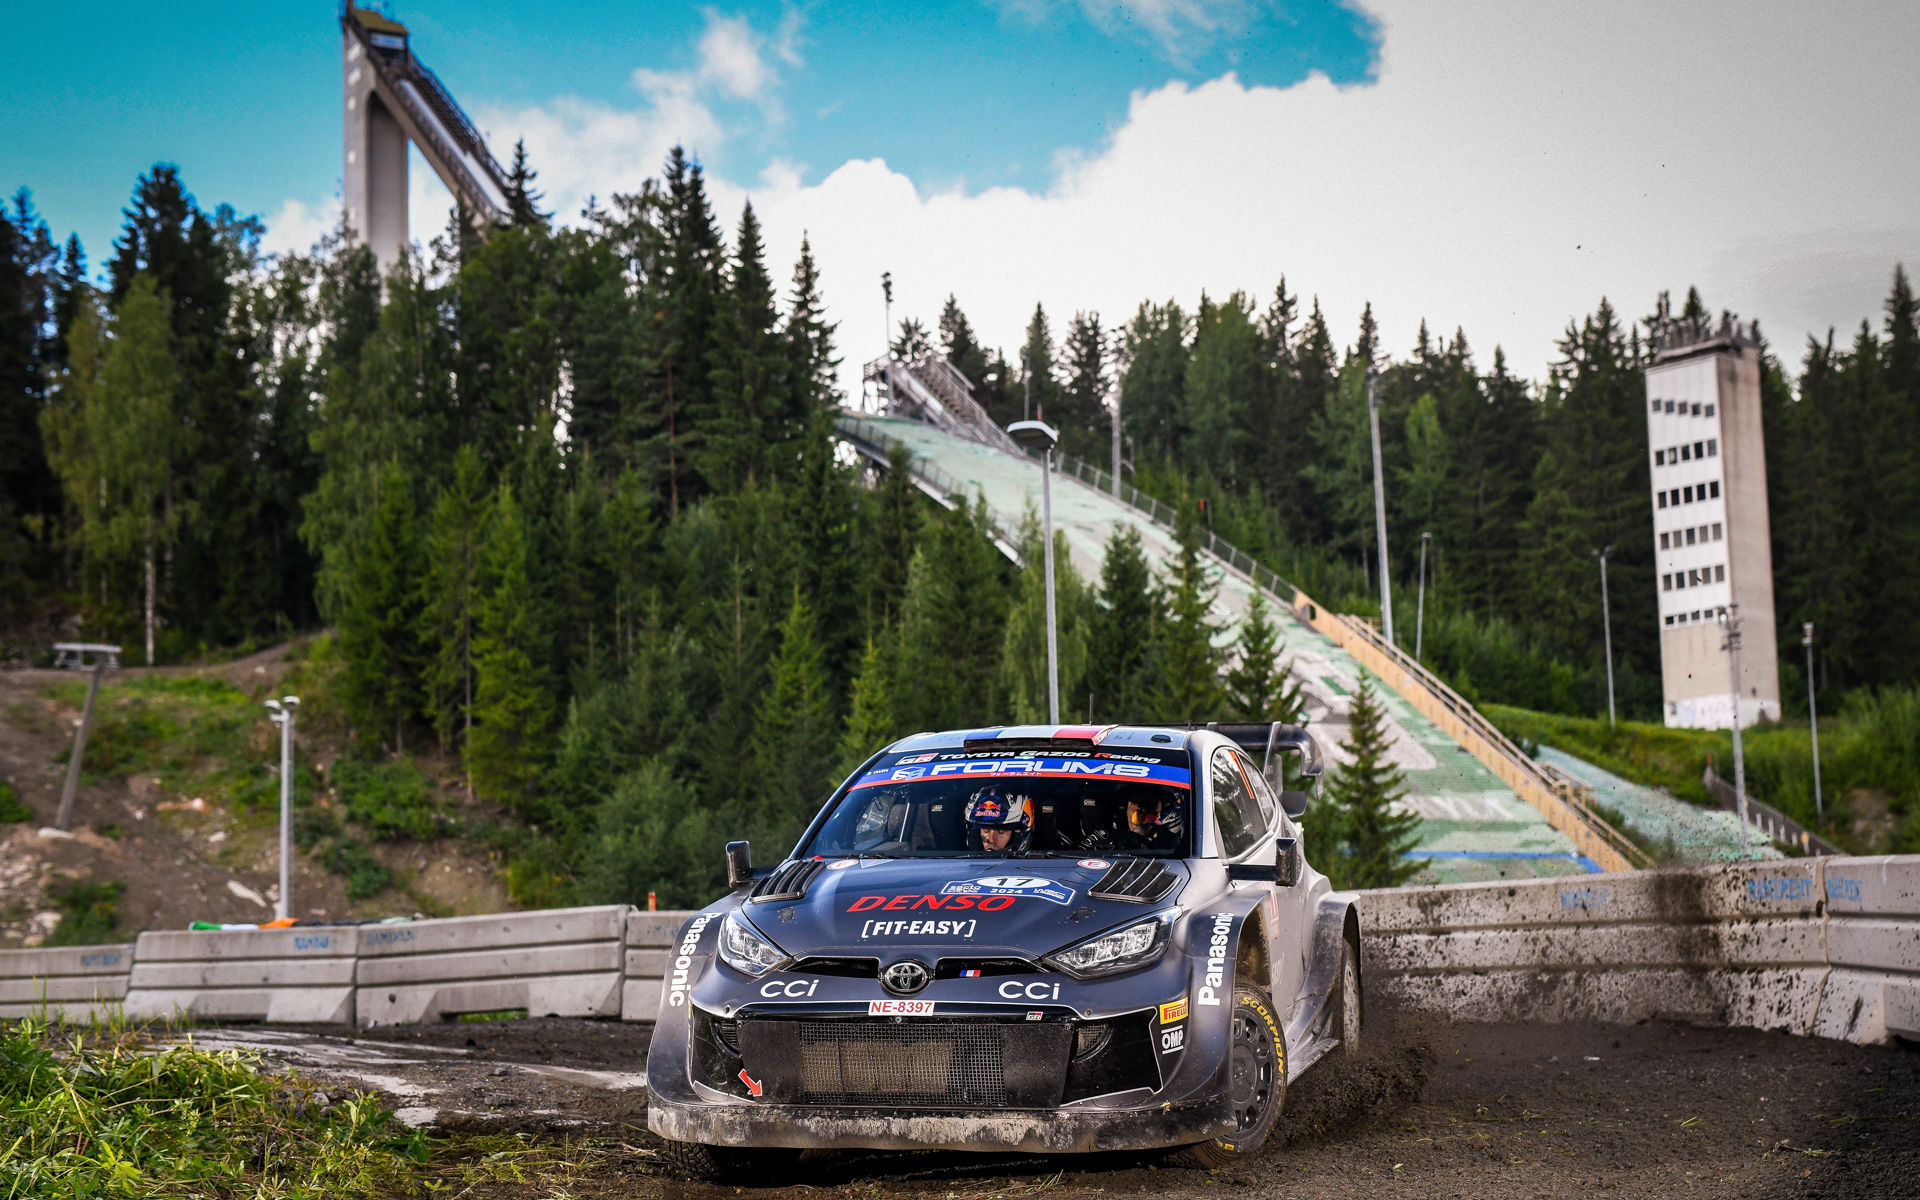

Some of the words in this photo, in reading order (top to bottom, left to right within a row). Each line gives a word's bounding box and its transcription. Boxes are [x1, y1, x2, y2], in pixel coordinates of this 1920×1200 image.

[939, 751, 1016, 761] TOYOTA
[1018, 750, 1091, 759] GAZOO
[1094, 752, 1161, 764] Racing
[930, 760, 1150, 778] FORUM8
[996, 878, 1034, 887] 17
[846, 895, 1016, 912] DENSO
[669, 912, 723, 1007] Panasonic
[1198, 912, 1235, 1006] Panasonic
[871, 1001, 933, 1013] NE-8397
[1163, 1001, 1187, 1021] PIRELLI
[1161, 1029, 1184, 1050] OMP
[1241, 996, 1284, 1075] SCORPION
